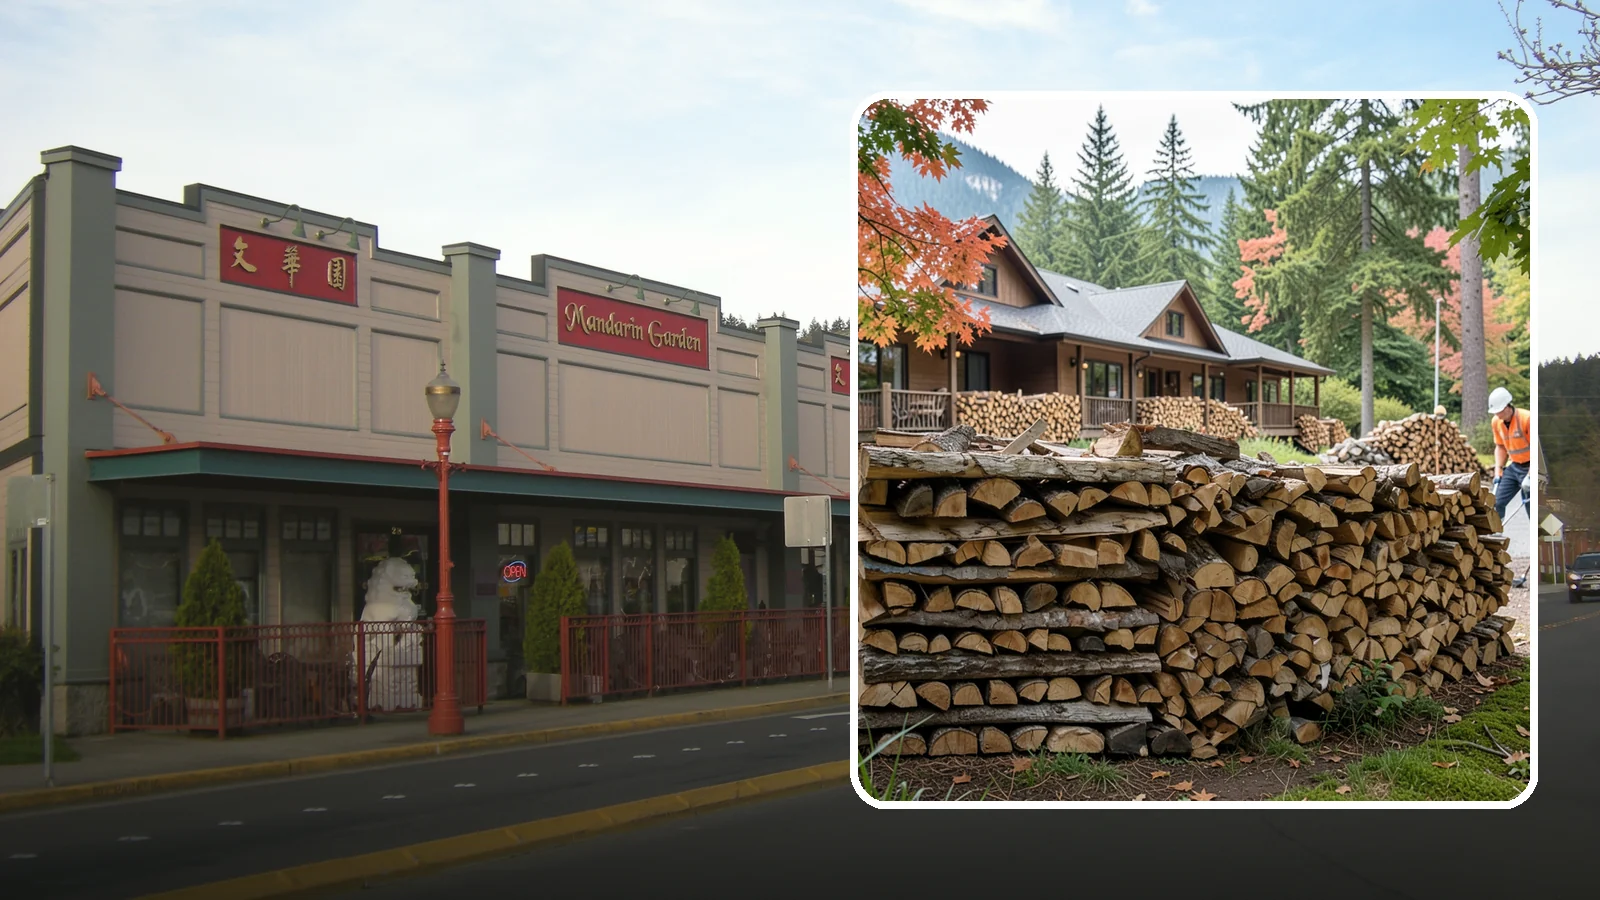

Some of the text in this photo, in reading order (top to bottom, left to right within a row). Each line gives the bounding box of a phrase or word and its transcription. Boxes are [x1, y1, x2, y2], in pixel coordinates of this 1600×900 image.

[231, 236, 347, 290] 文華園
[565, 302, 702, 352] Mandarin Garden
[835, 363, 846, 386] 文
[503, 565, 527, 578] OPEN
